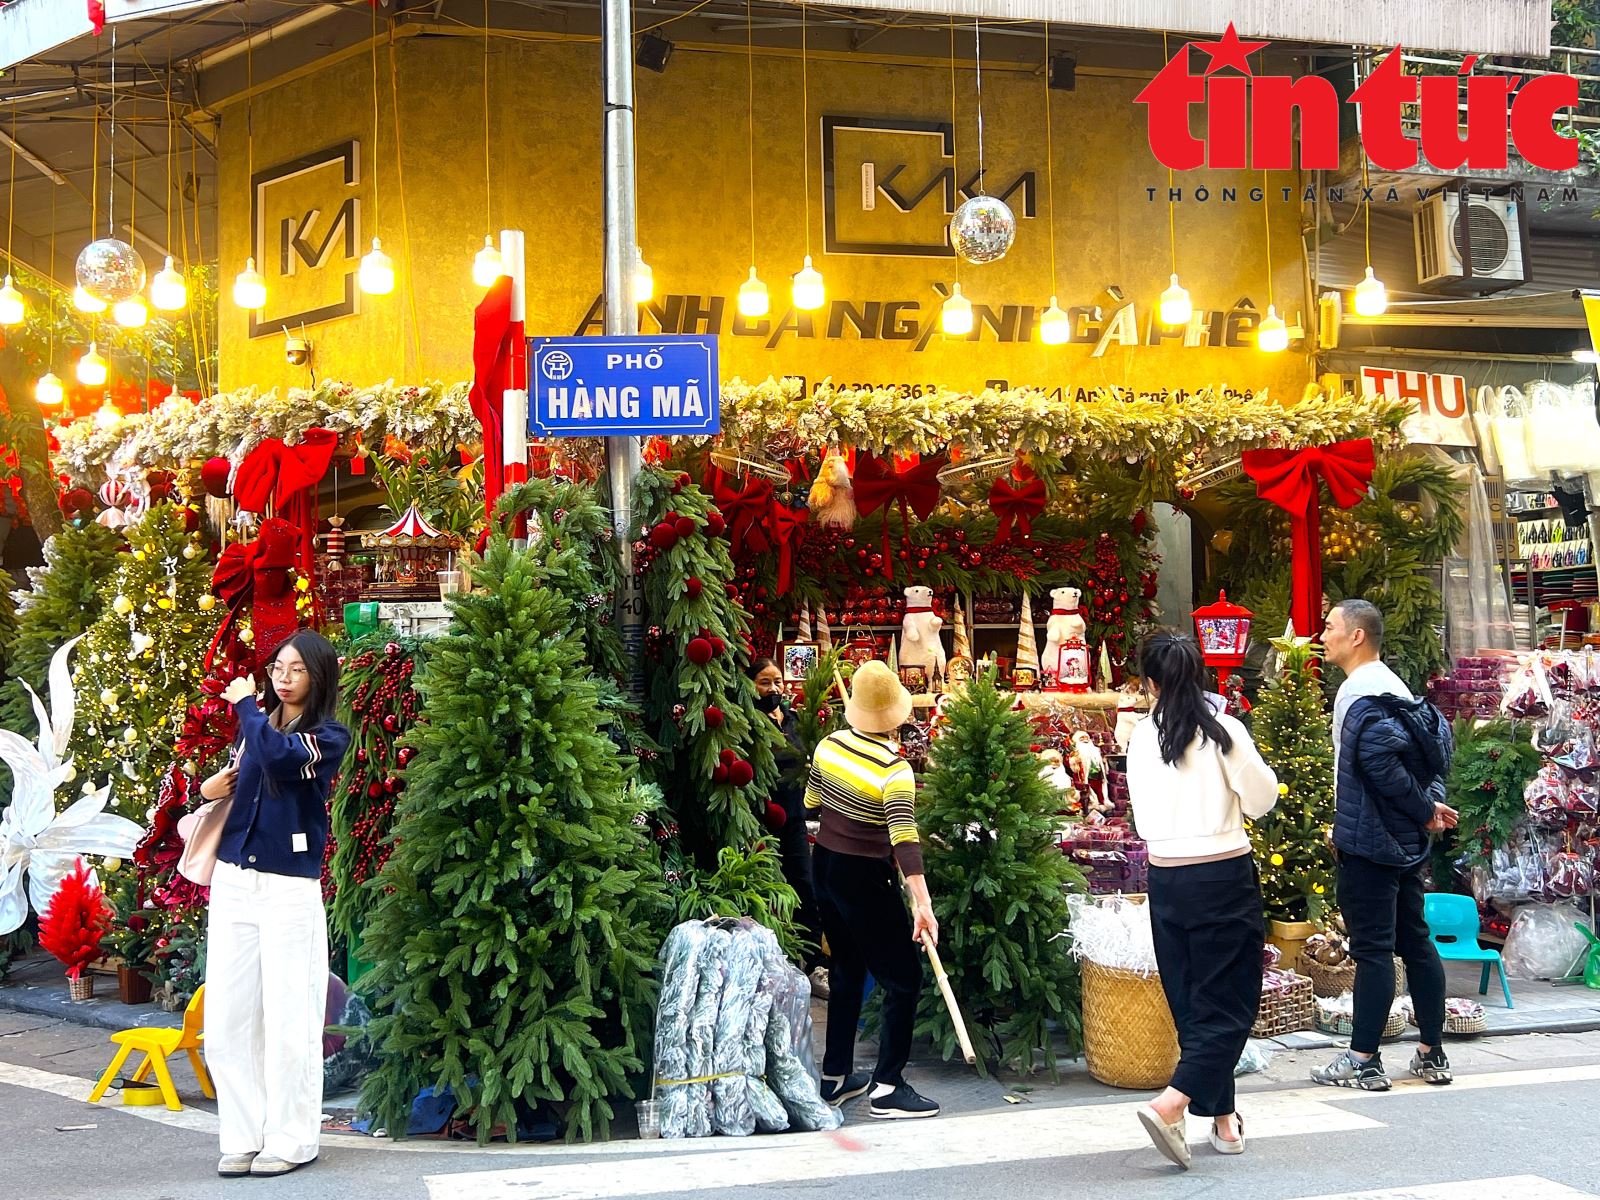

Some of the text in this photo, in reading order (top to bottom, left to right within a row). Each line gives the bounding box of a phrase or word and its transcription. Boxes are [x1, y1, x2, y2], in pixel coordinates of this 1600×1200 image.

[607, 346, 664, 369] PHỐ
[548, 378, 704, 419] HÀNG MÃ
[1363, 368, 1466, 419] THU
[620, 597, 643, 616] 40
